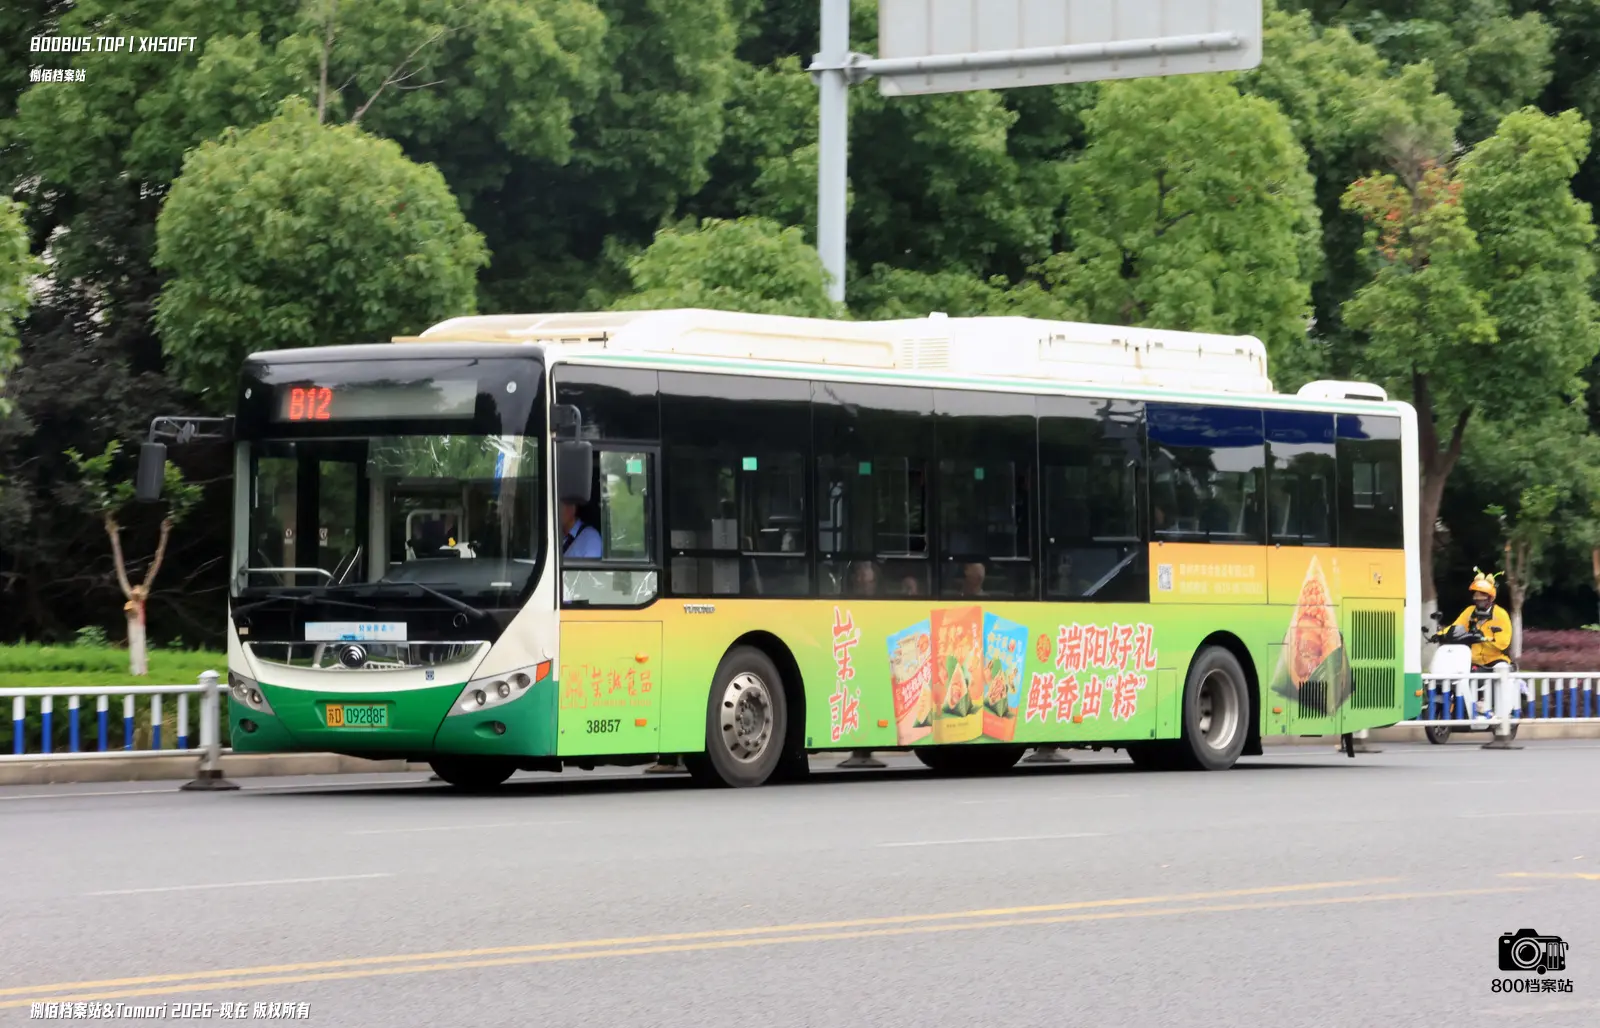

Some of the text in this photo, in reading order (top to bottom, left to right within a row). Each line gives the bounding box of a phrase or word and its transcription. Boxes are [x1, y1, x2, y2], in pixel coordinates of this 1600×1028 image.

[289, 387, 333, 420] B12
[1056, 622, 1158, 672] 端阳好礼
[586, 719, 621, 734] 38857
